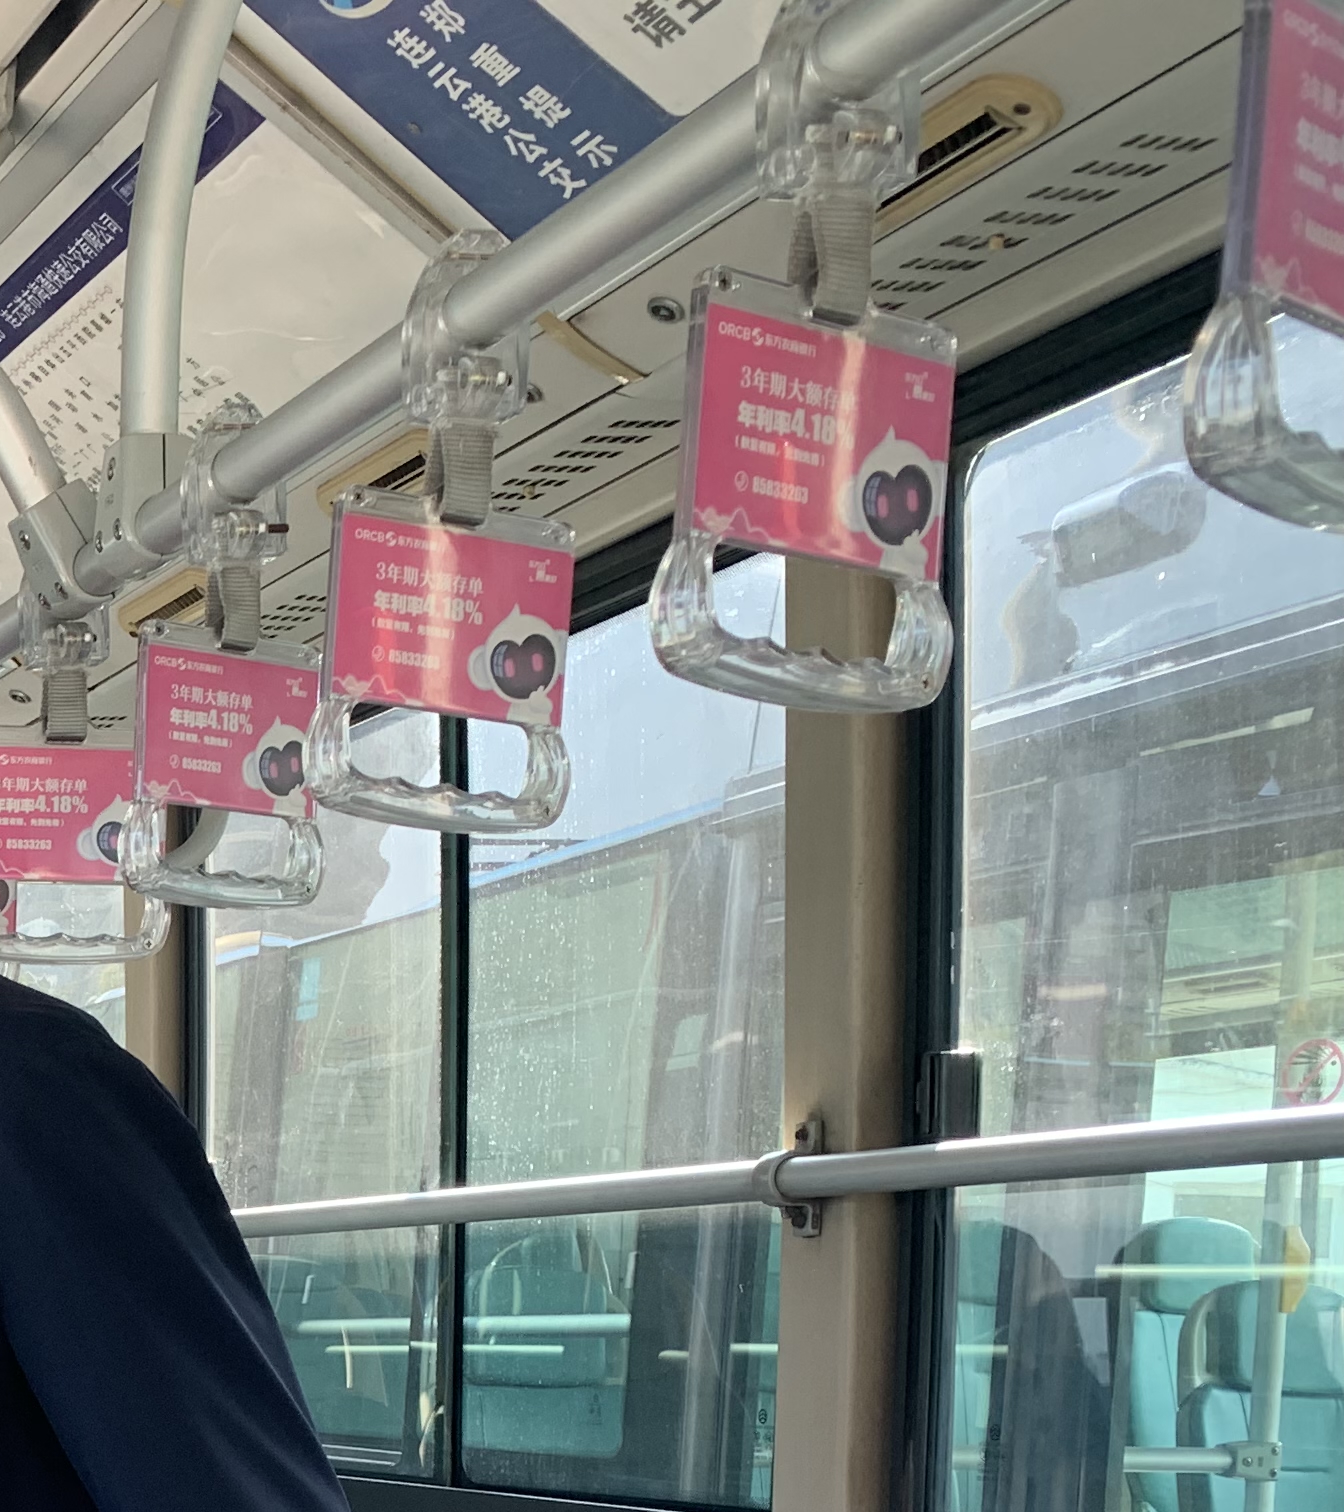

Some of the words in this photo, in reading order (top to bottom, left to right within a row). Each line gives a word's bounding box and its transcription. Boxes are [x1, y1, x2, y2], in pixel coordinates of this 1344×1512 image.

[419, 0, 620, 169] 郑重提示
[387, 25, 586, 199] 连云港公交
[718, 321, 752, 342] ORCB
[737, 400, 855, 452] 年利率4.18%
[354, 527, 385, 543] ORCB
[171, 683, 254, 712] 3年期大额存单
[170, 707, 254, 735] 年利率4.18%
